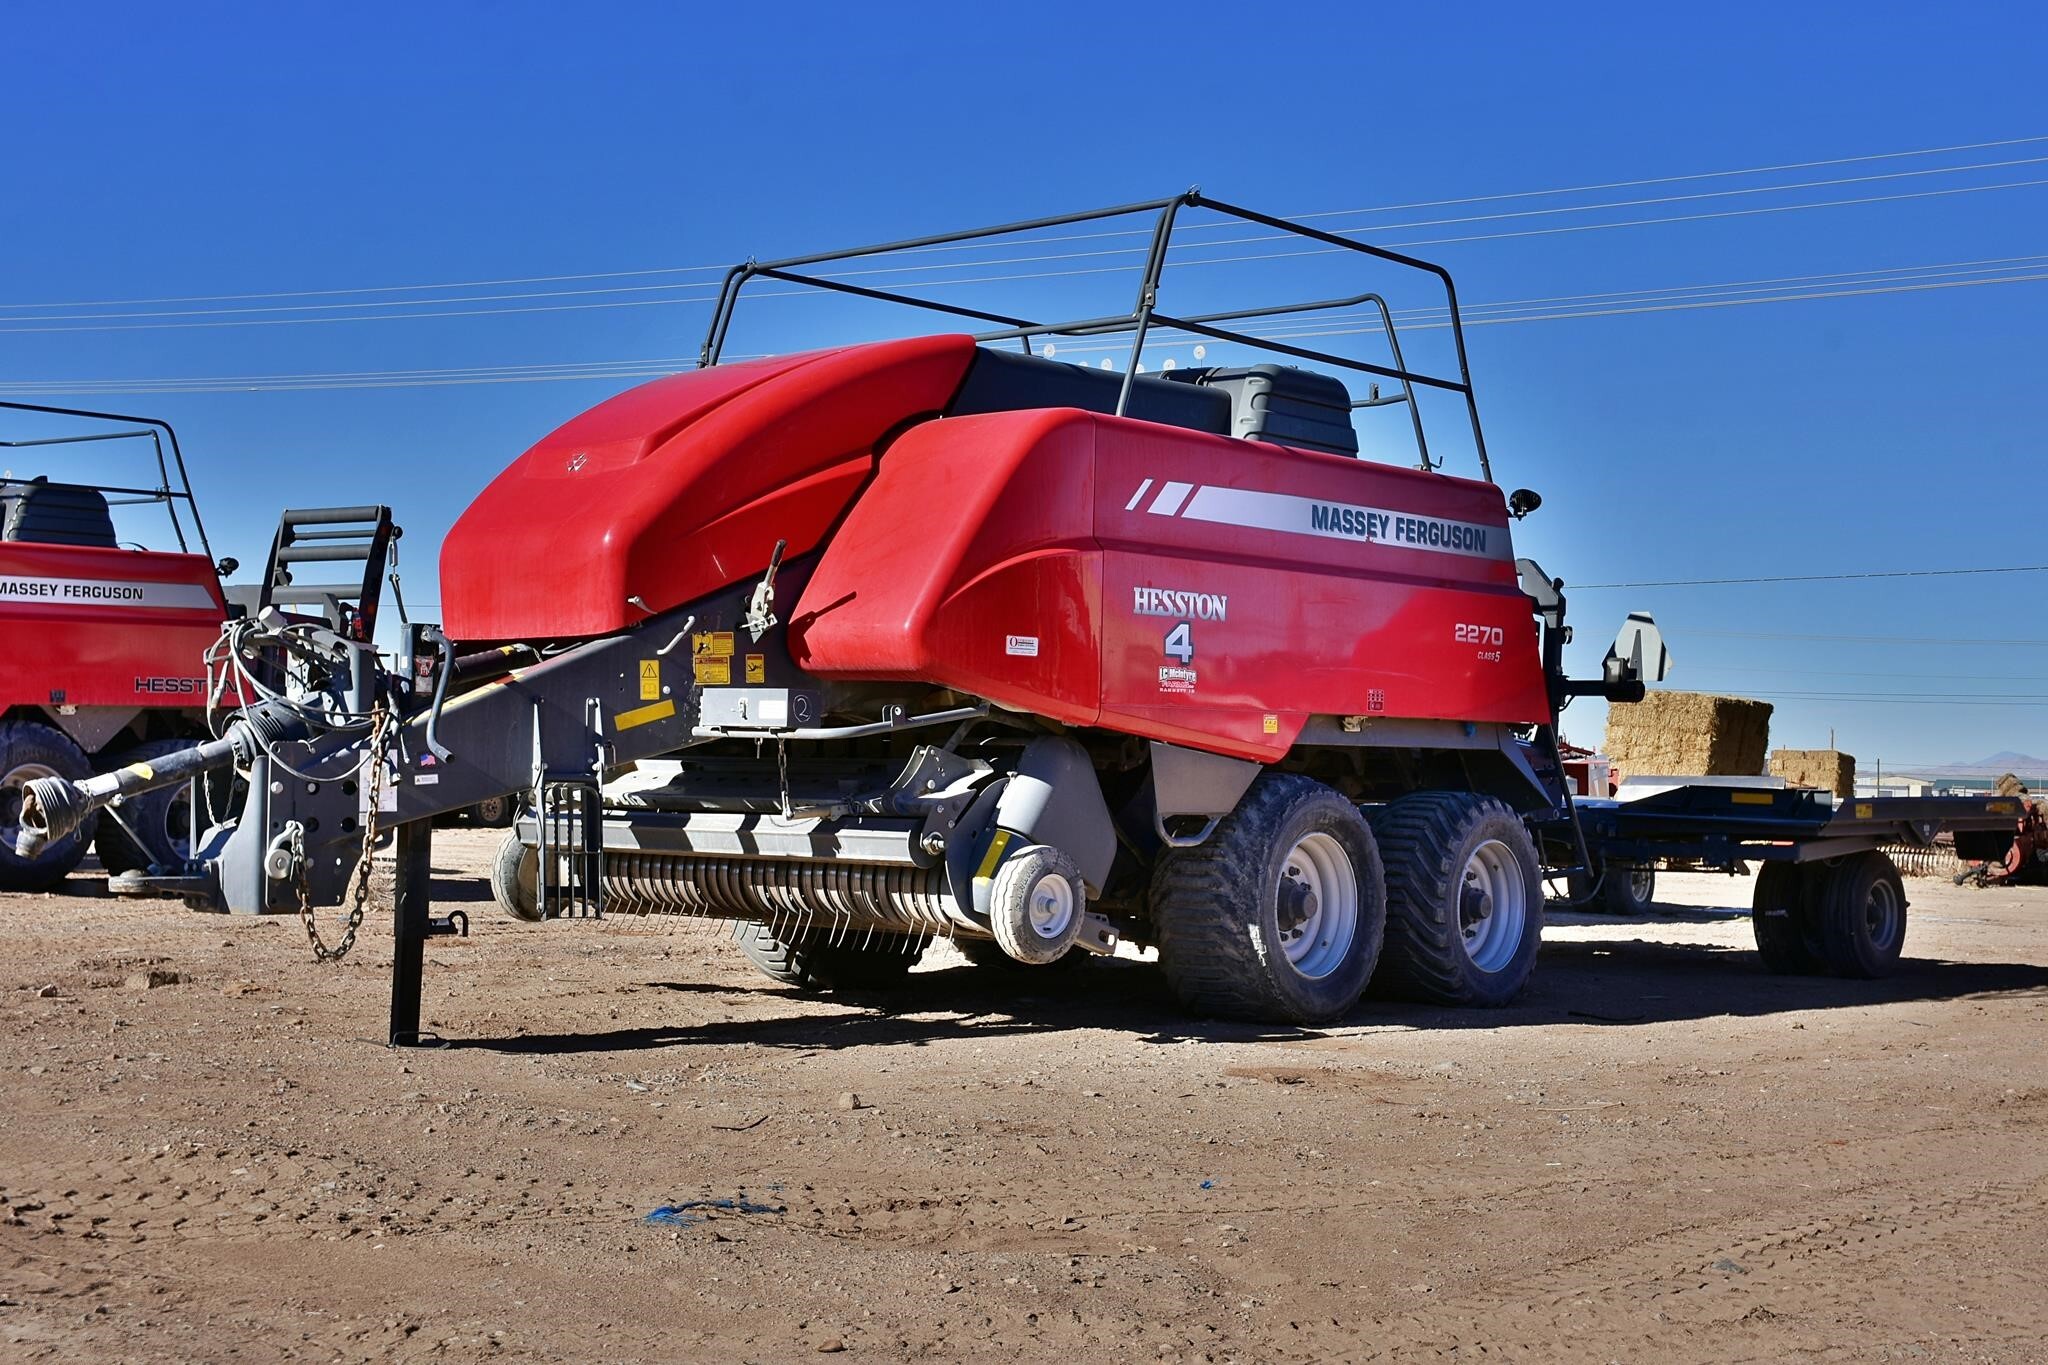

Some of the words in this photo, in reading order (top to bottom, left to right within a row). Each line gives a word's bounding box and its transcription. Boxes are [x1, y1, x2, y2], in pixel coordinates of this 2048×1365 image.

[1312, 504, 1390, 539] MASSEY
[1396, 517, 1486, 552] FERGUSON
[64, 585, 143, 600] FERGUSON
[1133, 587, 1228, 621] HESSTON
[1164, 622, 1193, 665] 4
[1455, 623, 1503, 646] 2270
[1477, 651, 1495, 661] CLASS
[1494, 651, 1501, 662] 5
[135, 676, 240, 694] HESSTN
[796, 697, 809, 718] 2
